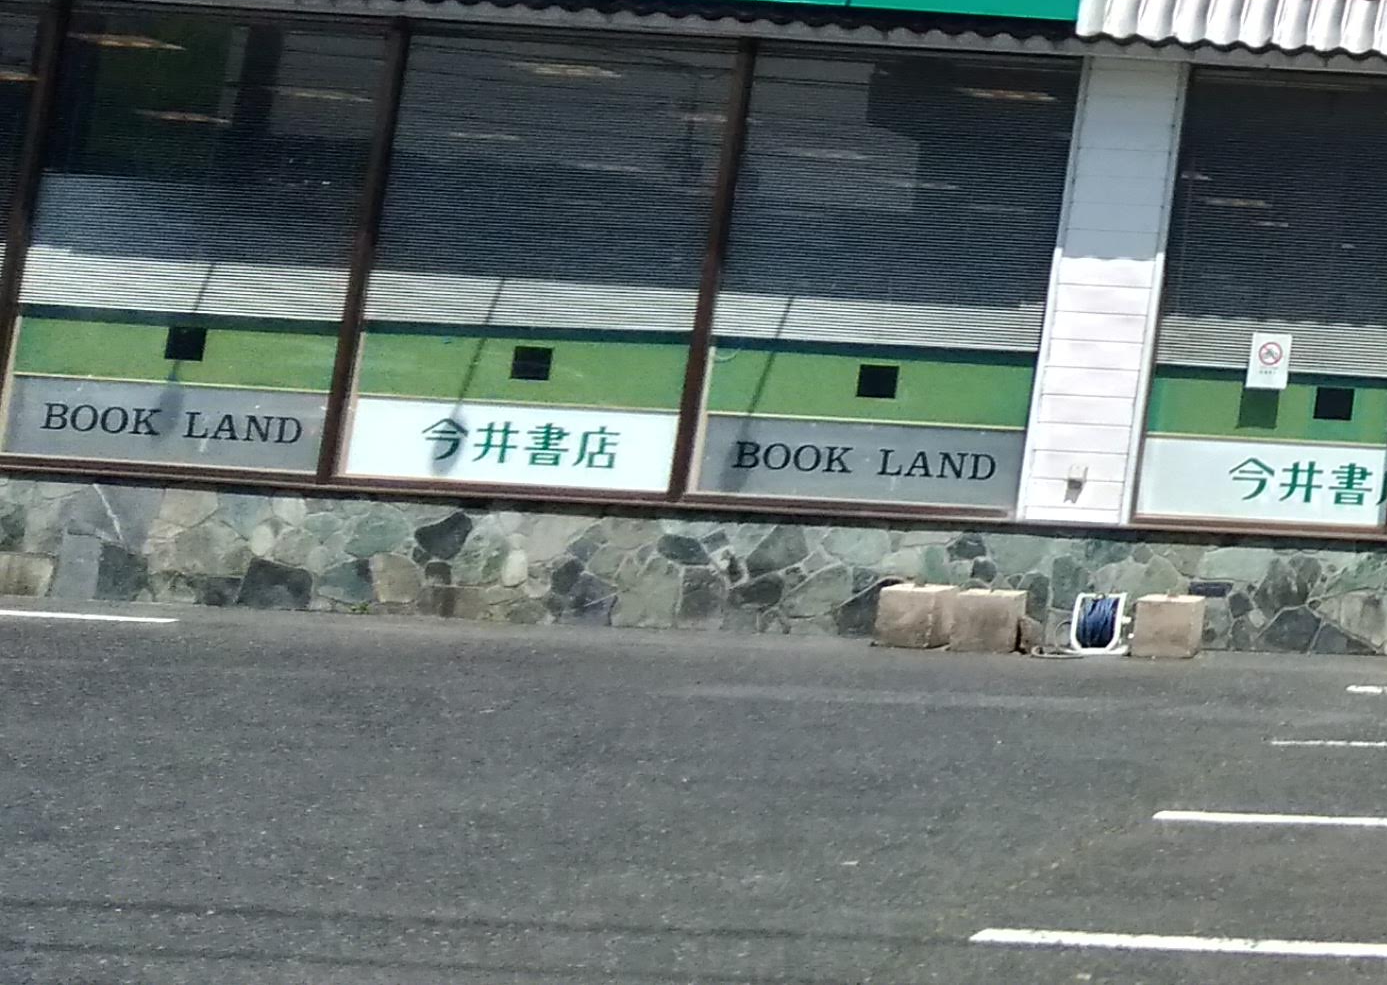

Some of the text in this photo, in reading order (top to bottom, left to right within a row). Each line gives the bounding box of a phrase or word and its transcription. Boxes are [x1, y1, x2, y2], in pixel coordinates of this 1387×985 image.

[41, 403, 303, 445] BOOK LAND
[422, 417, 621, 469] 今井書店
[732, 441, 996, 481] BOOK LAND
